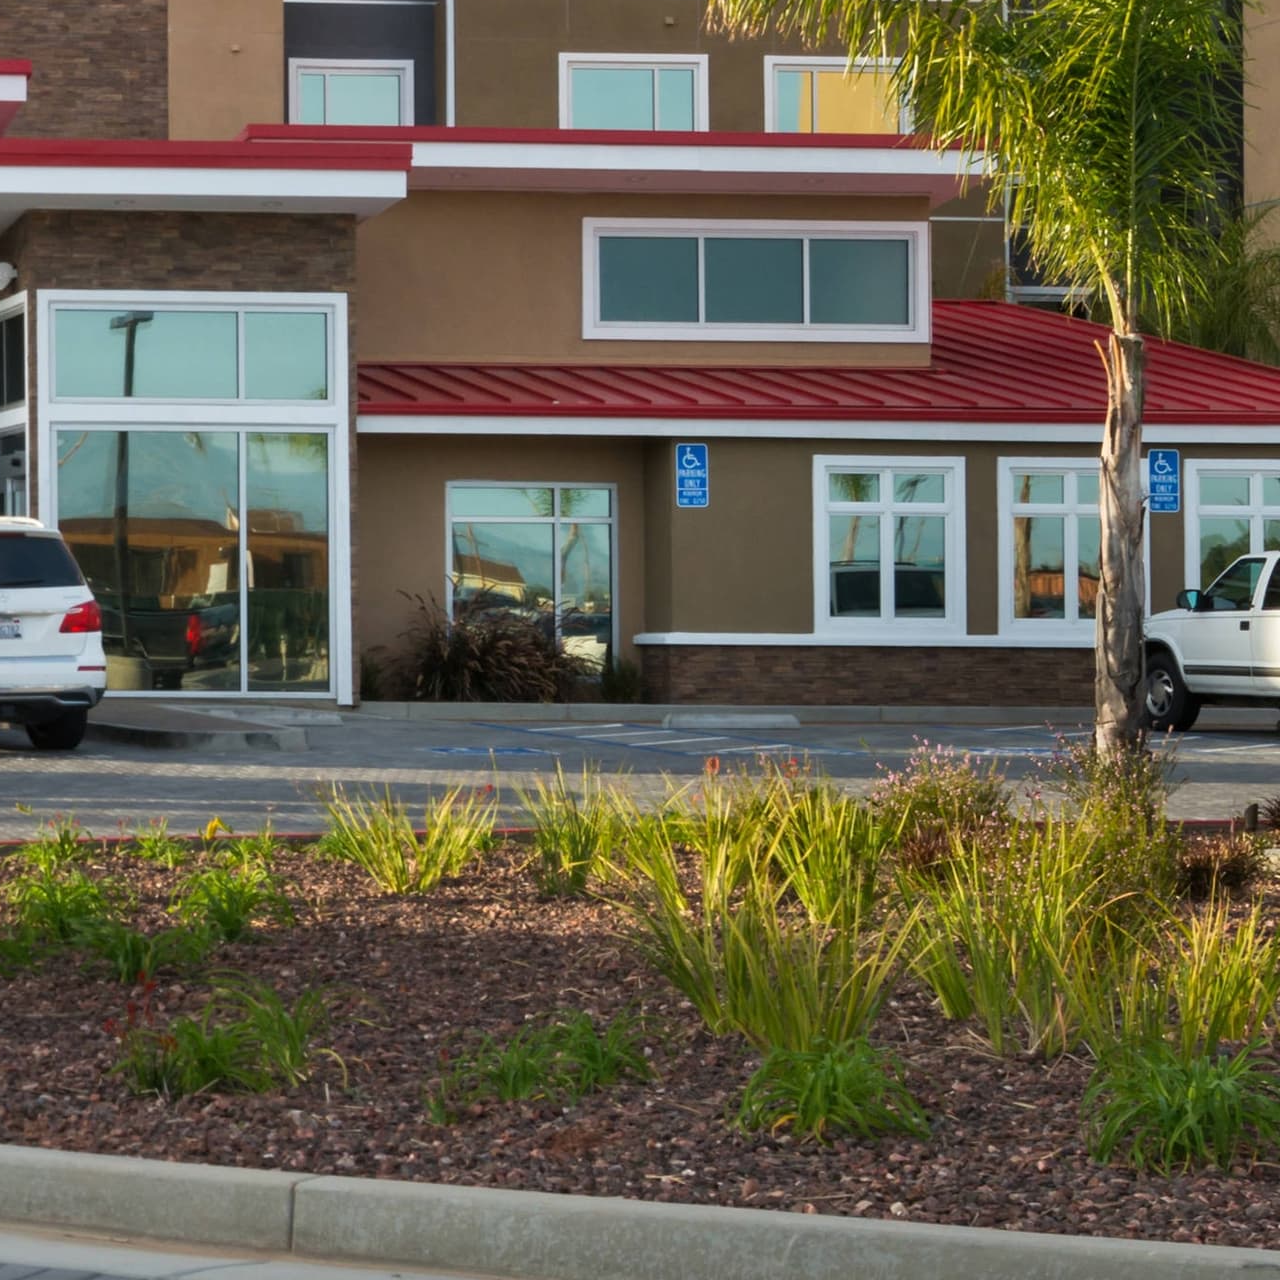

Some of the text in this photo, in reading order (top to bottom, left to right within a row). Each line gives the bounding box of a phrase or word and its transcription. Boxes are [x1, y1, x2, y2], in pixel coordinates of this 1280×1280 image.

[678, 469, 706, 478] PARKING
[1151, 474, 1177, 483] PARKING
[684, 479, 701, 488] ONLY
[1155, 484, 1172, 493] ONLY
